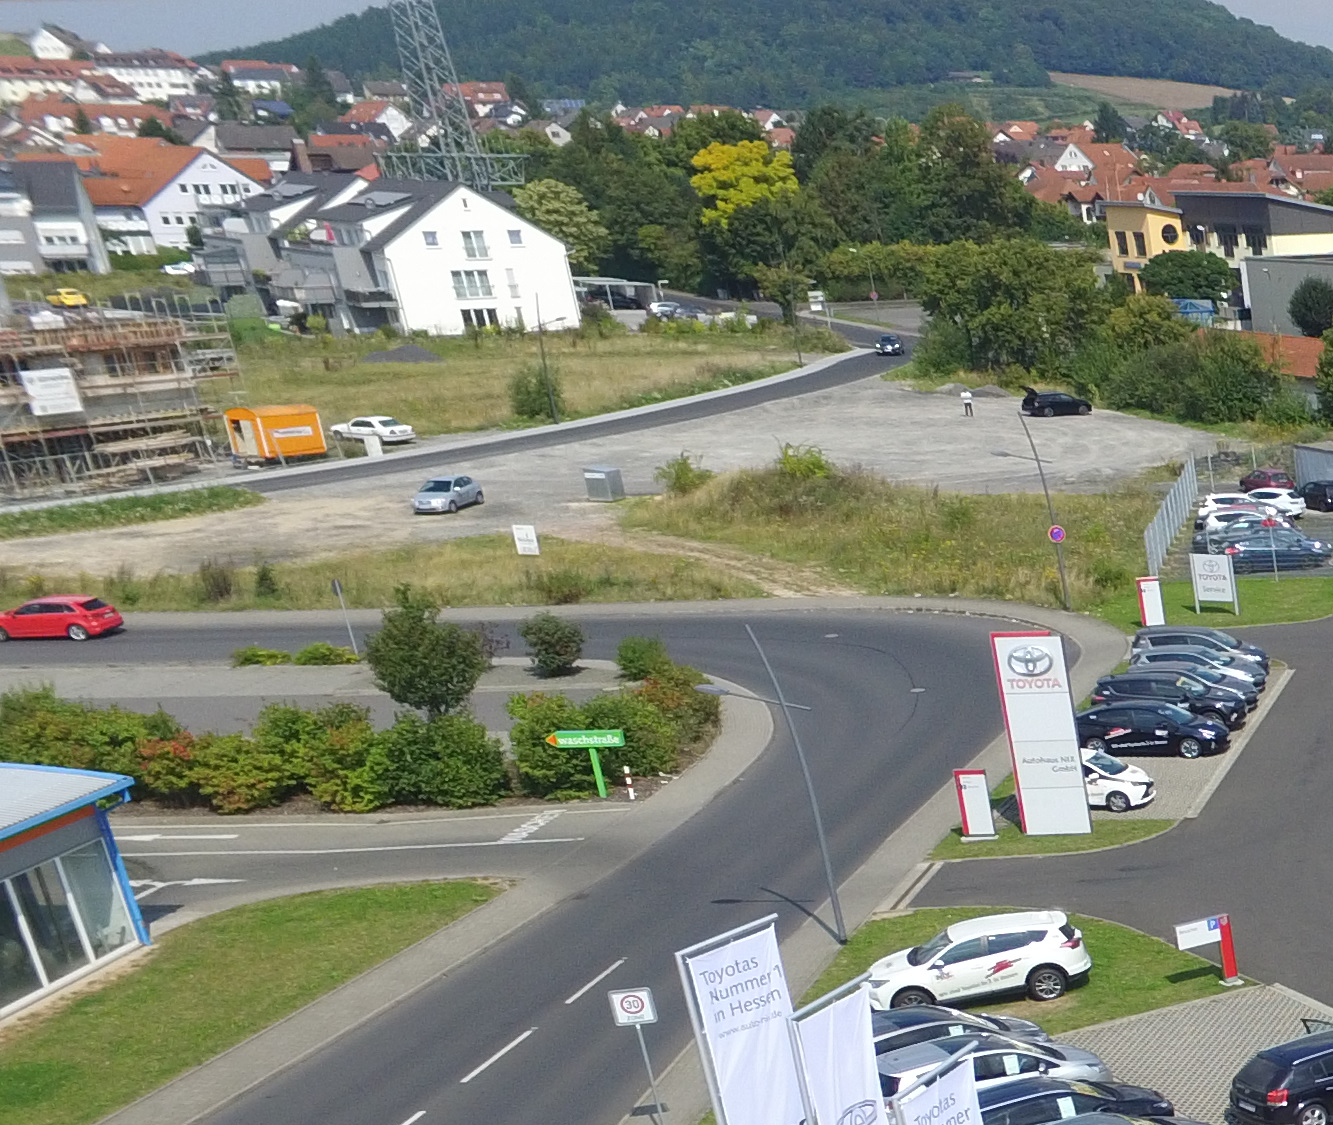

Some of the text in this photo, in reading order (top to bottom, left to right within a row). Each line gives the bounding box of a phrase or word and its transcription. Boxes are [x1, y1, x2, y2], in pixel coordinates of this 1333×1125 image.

[1007, 678, 1062, 689] TOYOTA
[699, 956, 759, 986] Toyotas
[709, 971, 772, 1005] Nummer
[624, 999, 640, 1010] 30
[714, 988, 782, 1024] in Hessen
